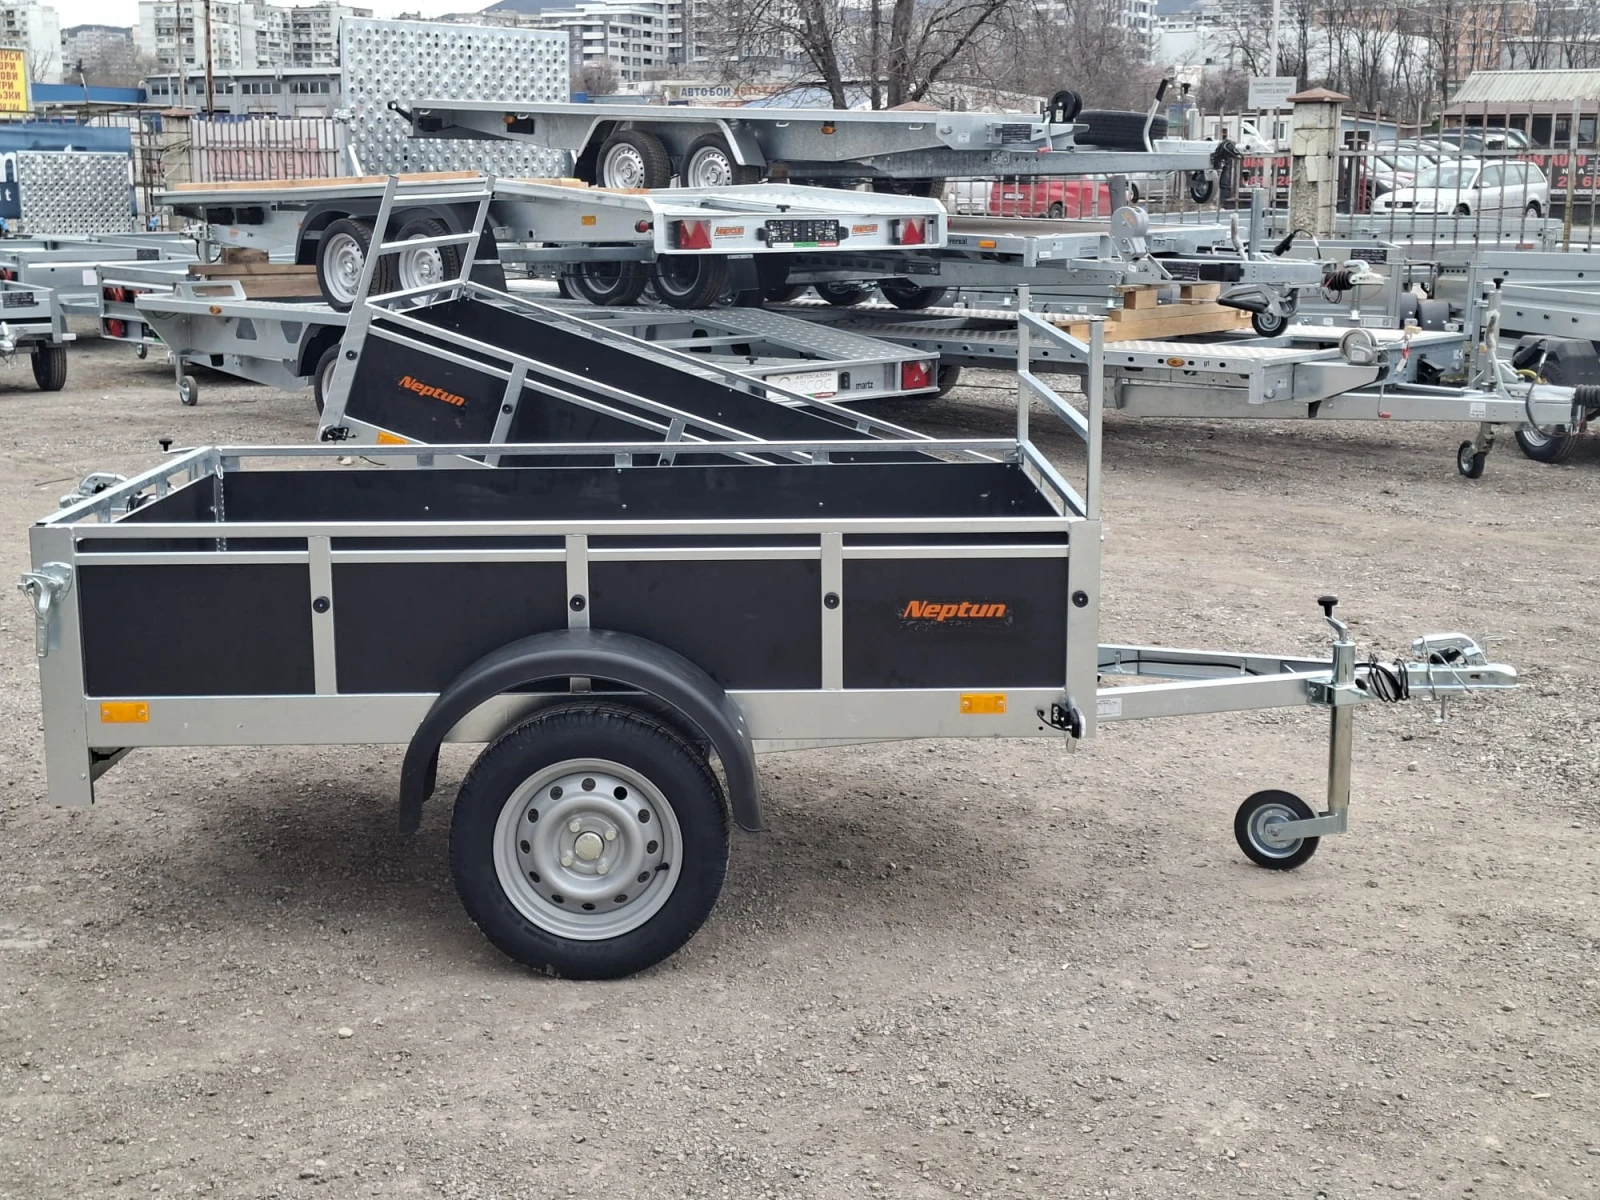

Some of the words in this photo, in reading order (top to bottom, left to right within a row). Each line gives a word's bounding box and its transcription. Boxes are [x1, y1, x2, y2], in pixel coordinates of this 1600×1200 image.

[399, 376, 465, 406] Neptun
[855, 381, 874, 389] martz
[903, 600, 1006, 621] Neptun
